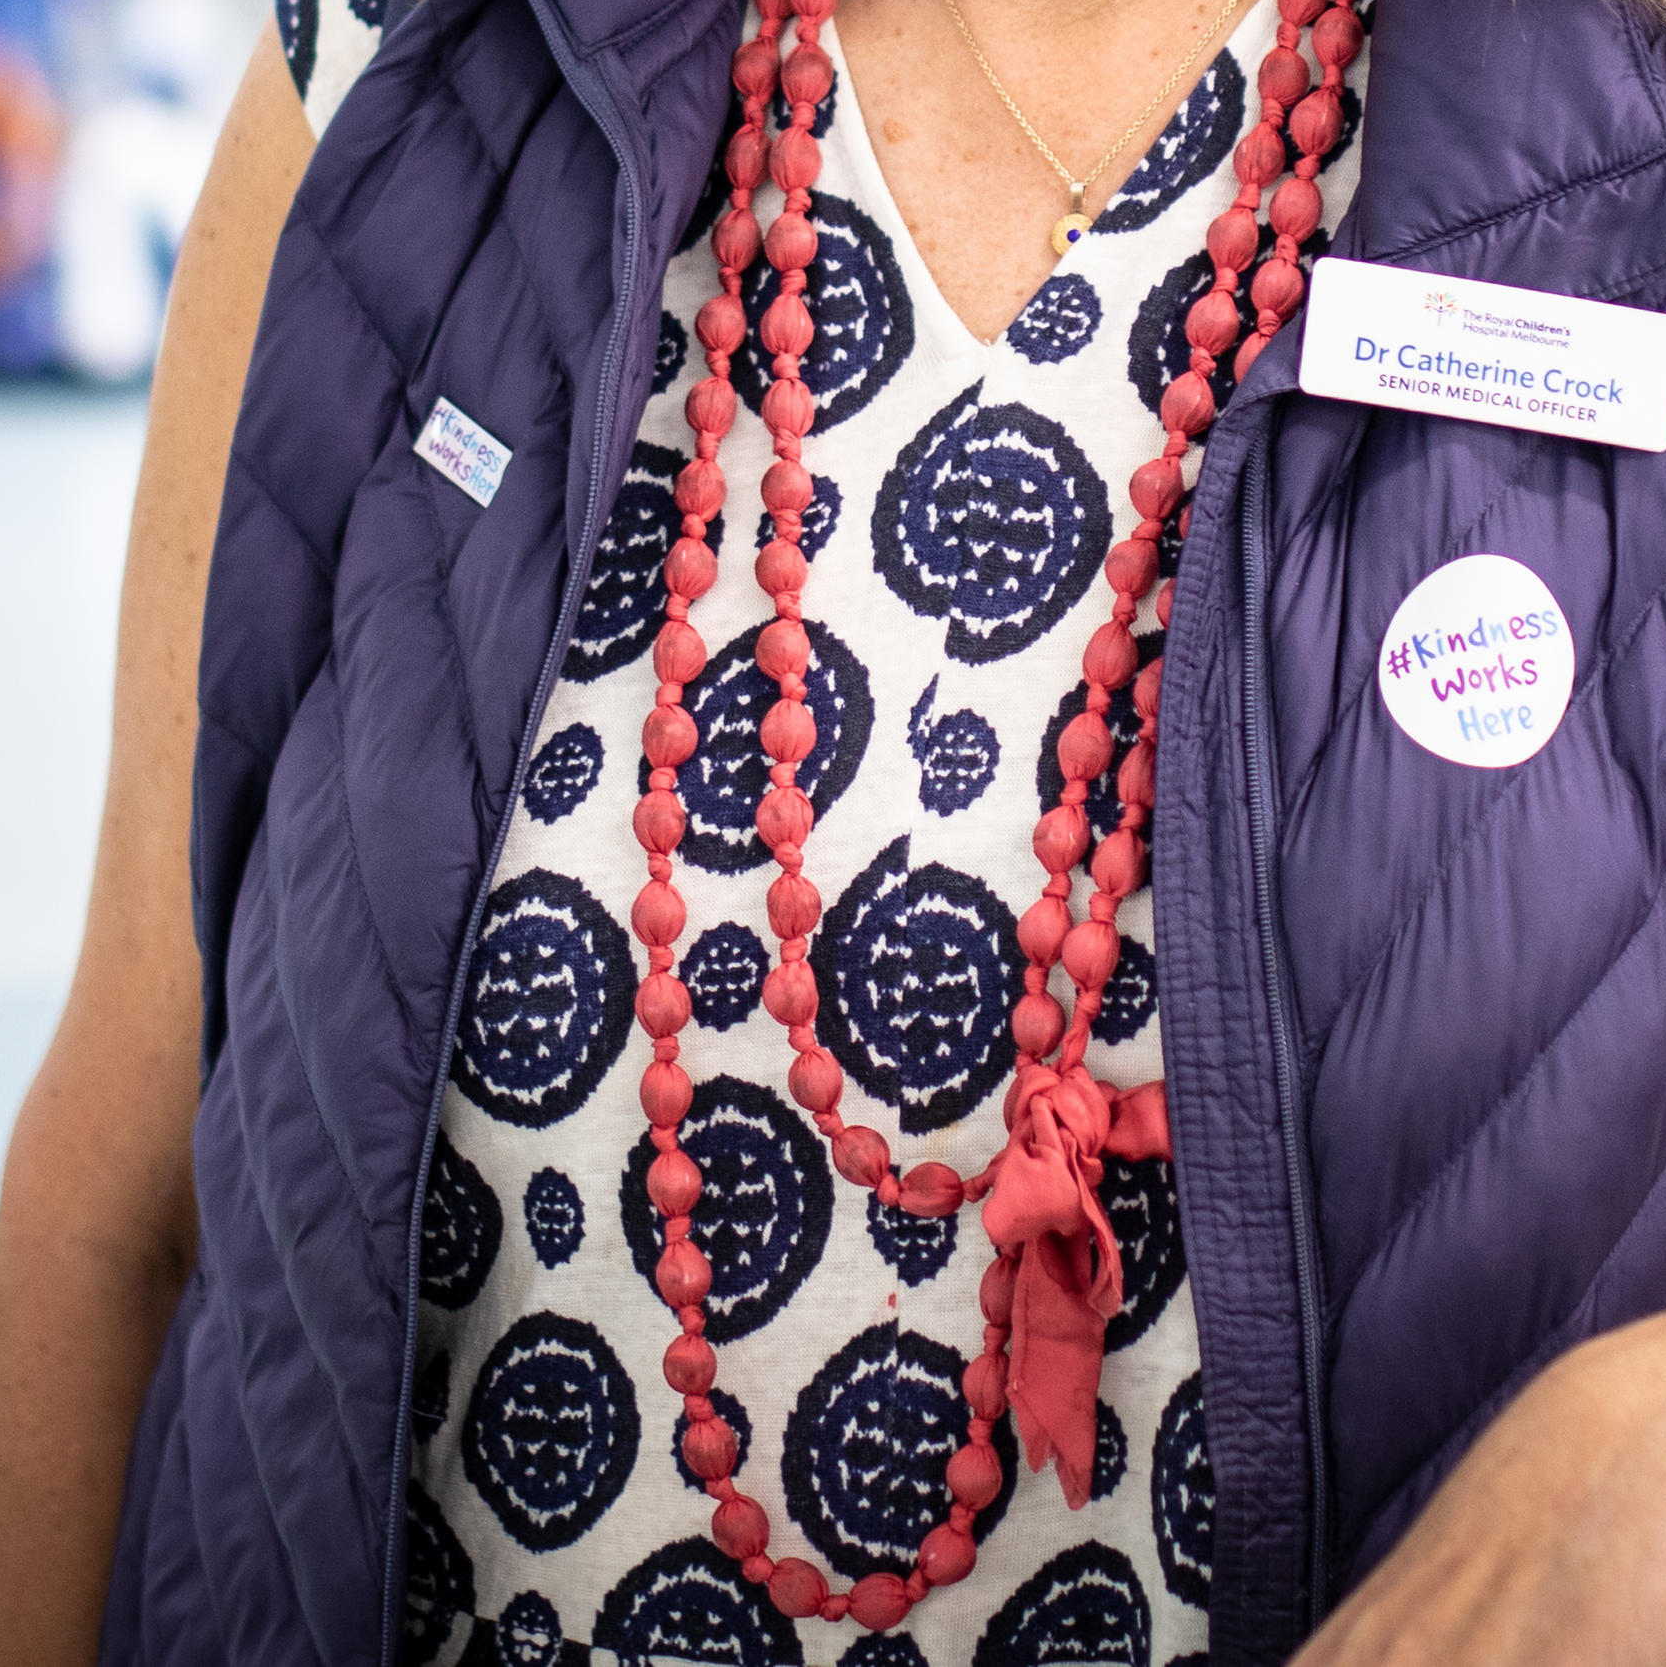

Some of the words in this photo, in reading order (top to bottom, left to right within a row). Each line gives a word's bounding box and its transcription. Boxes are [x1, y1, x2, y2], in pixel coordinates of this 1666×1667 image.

[1463, 309, 1482, 322] The
[1484, 313, 1514, 329] Royal
[1515, 318, 1572, 337] Children's
[1463, 321, 1510, 340] Hospital
[1511, 330, 1570, 348] Melbourne
[1355, 337, 1389, 364] Dr
[1398, 345, 1535, 388] Catherine
[1544, 369, 1623, 404] Crock
[1379, 374, 1441, 396] SENIOR
[1446, 385, 1522, 410] MEDICAL
[1529, 399, 1598, 423] OFFICER
[1387, 610, 1558, 679] #Kindness
[1457, 705, 1534, 742] Here
